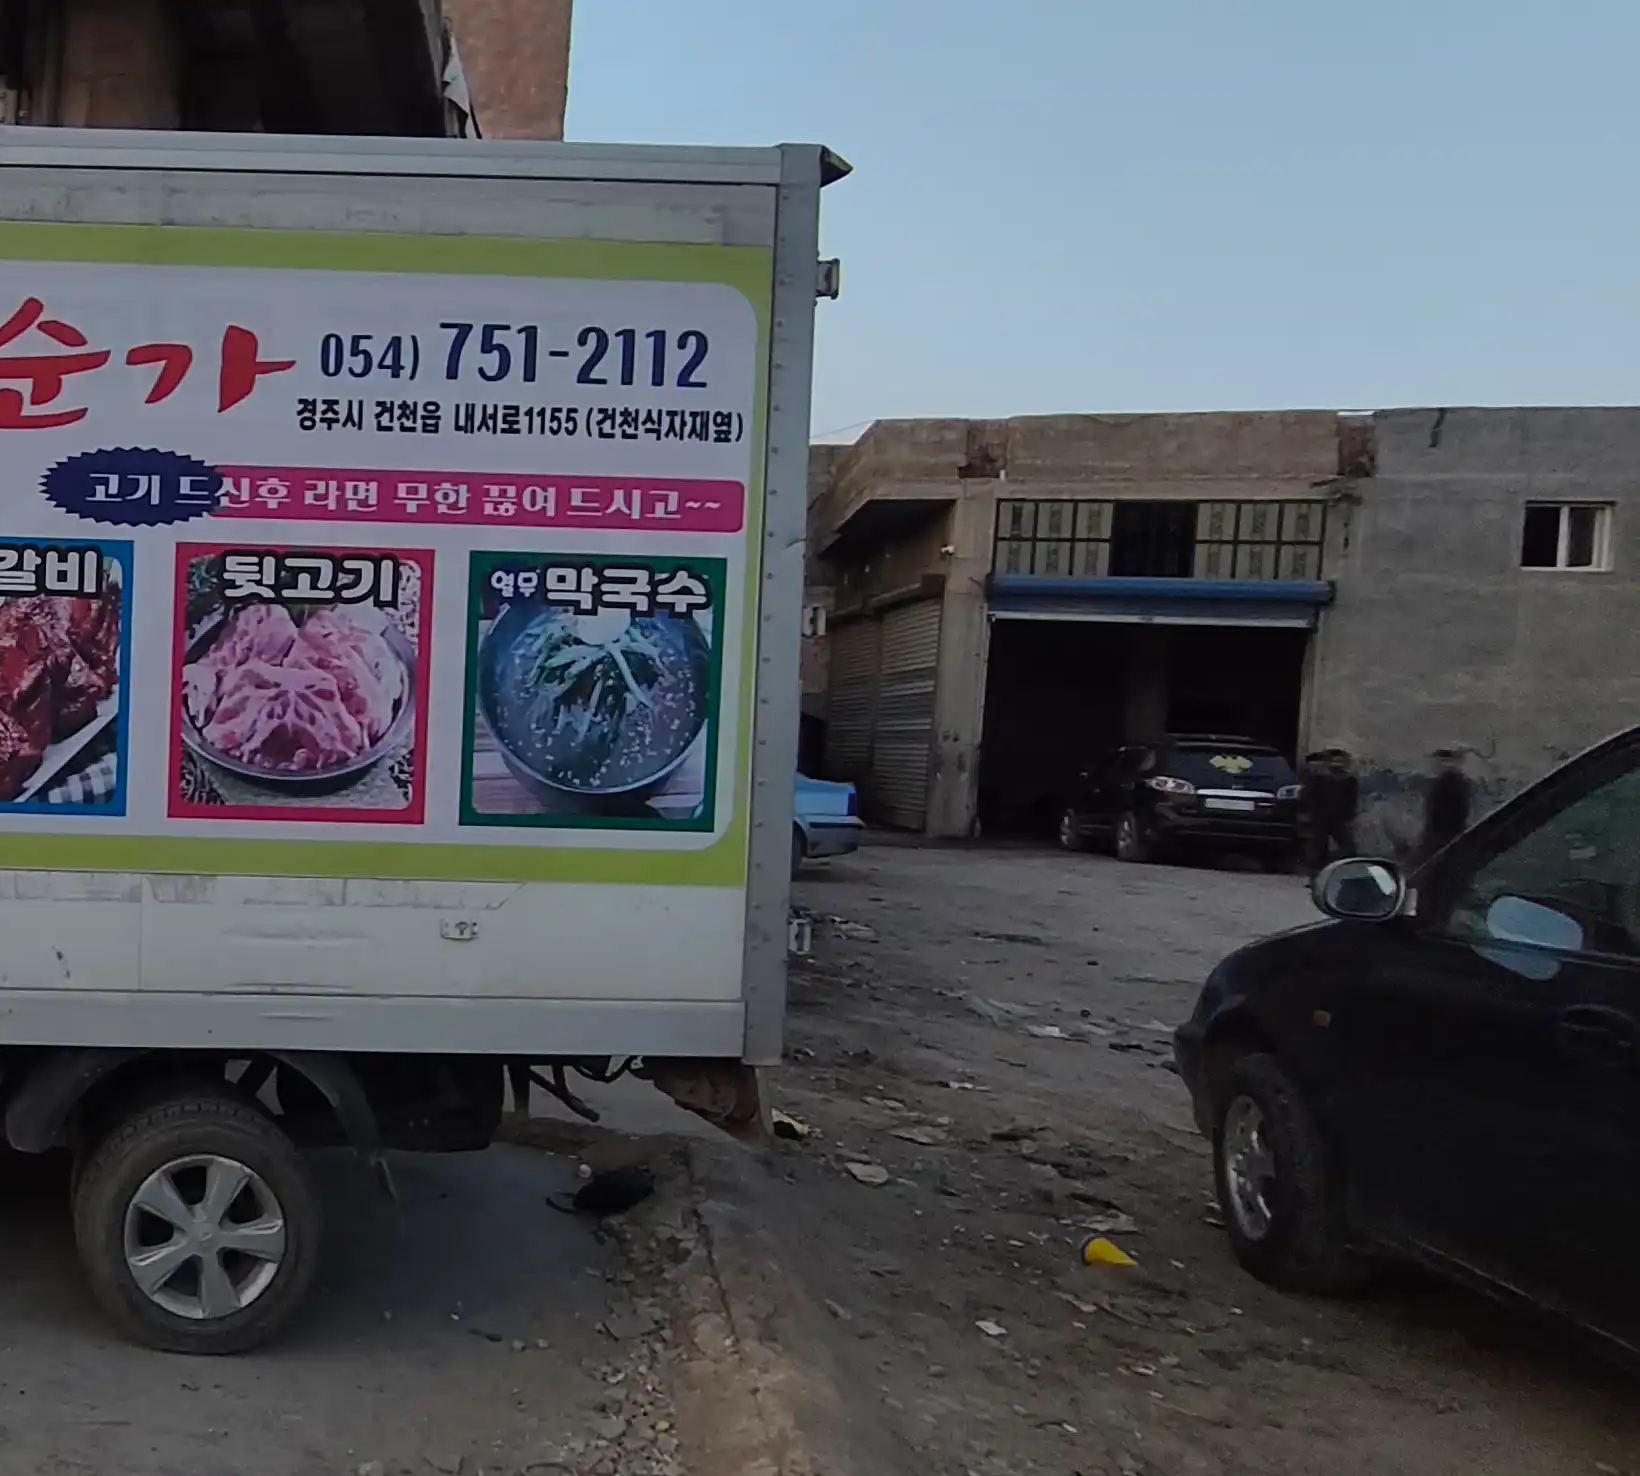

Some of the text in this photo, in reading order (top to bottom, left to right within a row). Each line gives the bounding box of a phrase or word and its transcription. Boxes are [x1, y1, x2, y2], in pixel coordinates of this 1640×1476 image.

[320, 322, 709, 389] 054) 751-2112
[296, 398, 744, 444] 경주시 건천읍 내서로1155 (건천식자재옆)
[85, 474, 160, 504] 고기
[175, 475, 291, 509] 드신후
[304, 479, 378, 511] 라면
[394, 482, 470, 514] 무한
[221, 555, 395, 604] 뒷고기
[545, 567, 708, 613] 막국수
